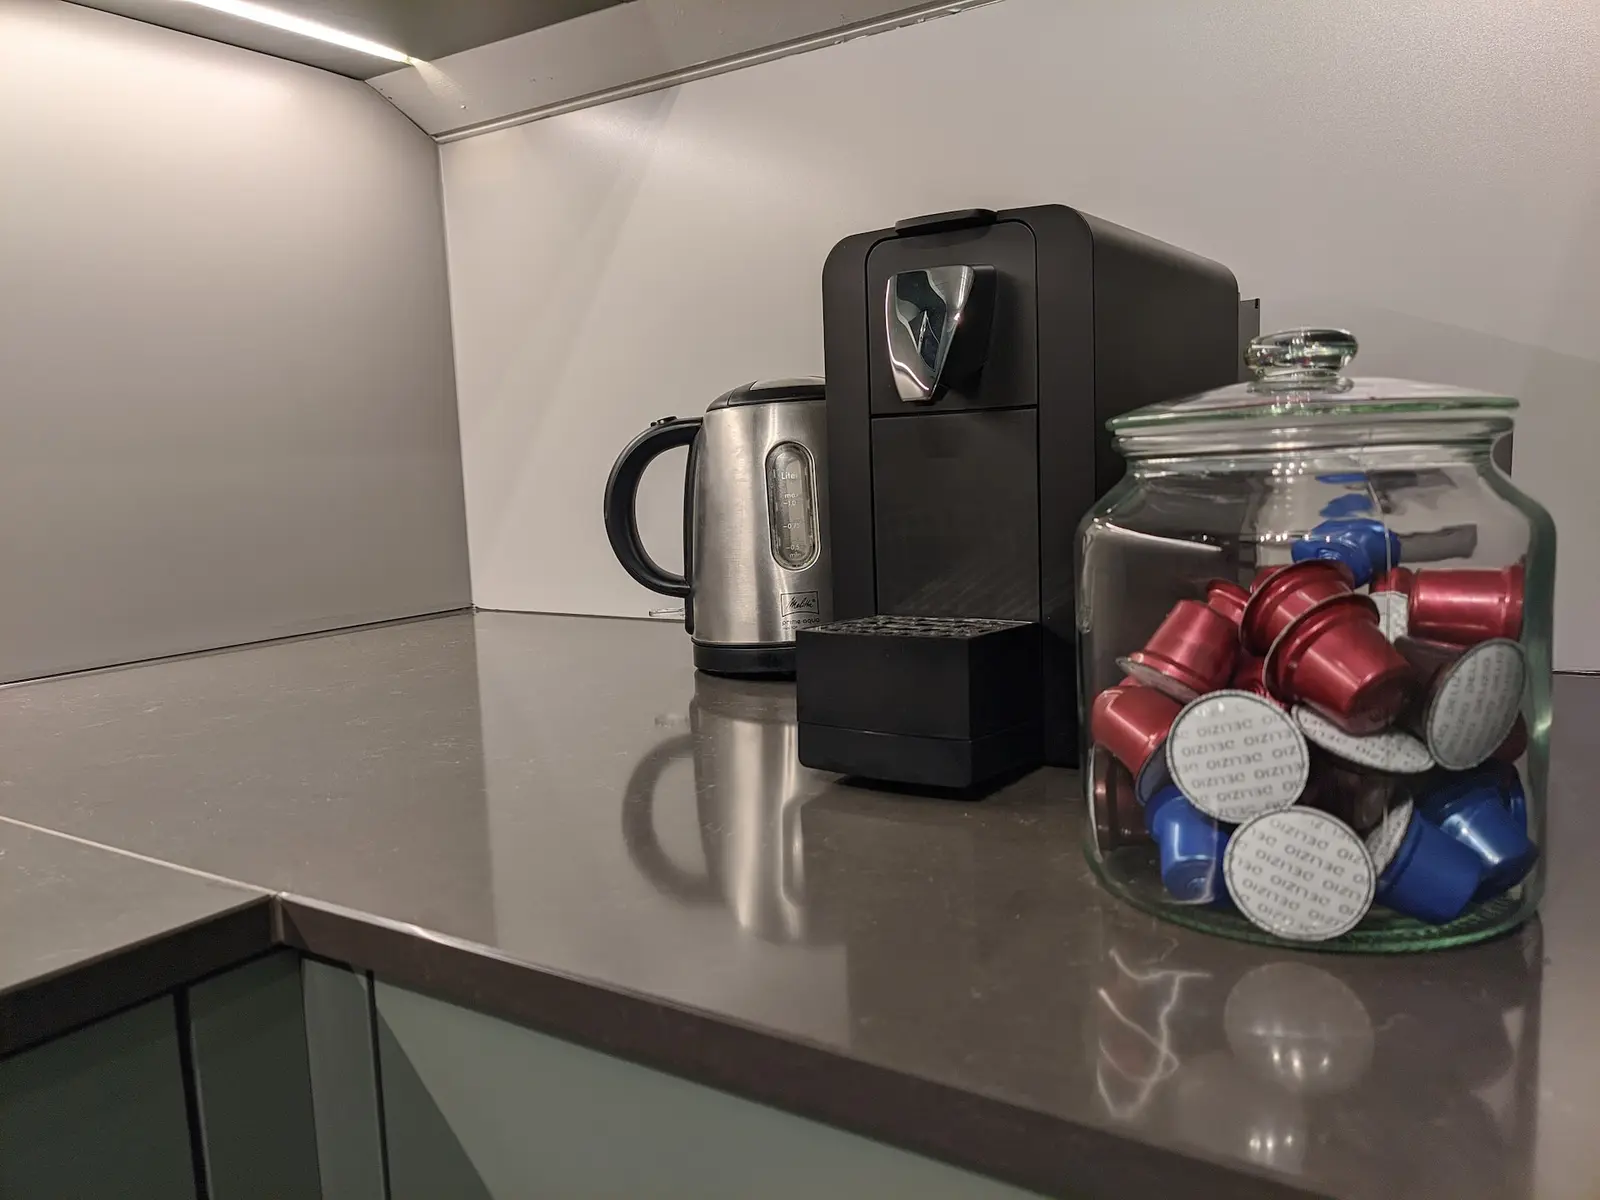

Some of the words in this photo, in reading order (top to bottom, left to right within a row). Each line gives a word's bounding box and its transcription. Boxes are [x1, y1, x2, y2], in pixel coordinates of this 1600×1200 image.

[1196, 718, 1252, 737] DELIZIO
[1180, 738, 1235, 757] DELIZIO
[1205, 751, 1262, 770] DELIZIO
[1191, 771, 1245, 790] DELIZIO
[1216, 784, 1272, 803] DELIZIO
[1268, 818, 1328, 851] DELIZIO
[1254, 848, 1314, 882] DELIZIO
[1283, 843, 1345, 877] DELIZIO
[1241, 877, 1300, 911] DELIZIO
[1268, 873, 1330, 906] DELIZIO
